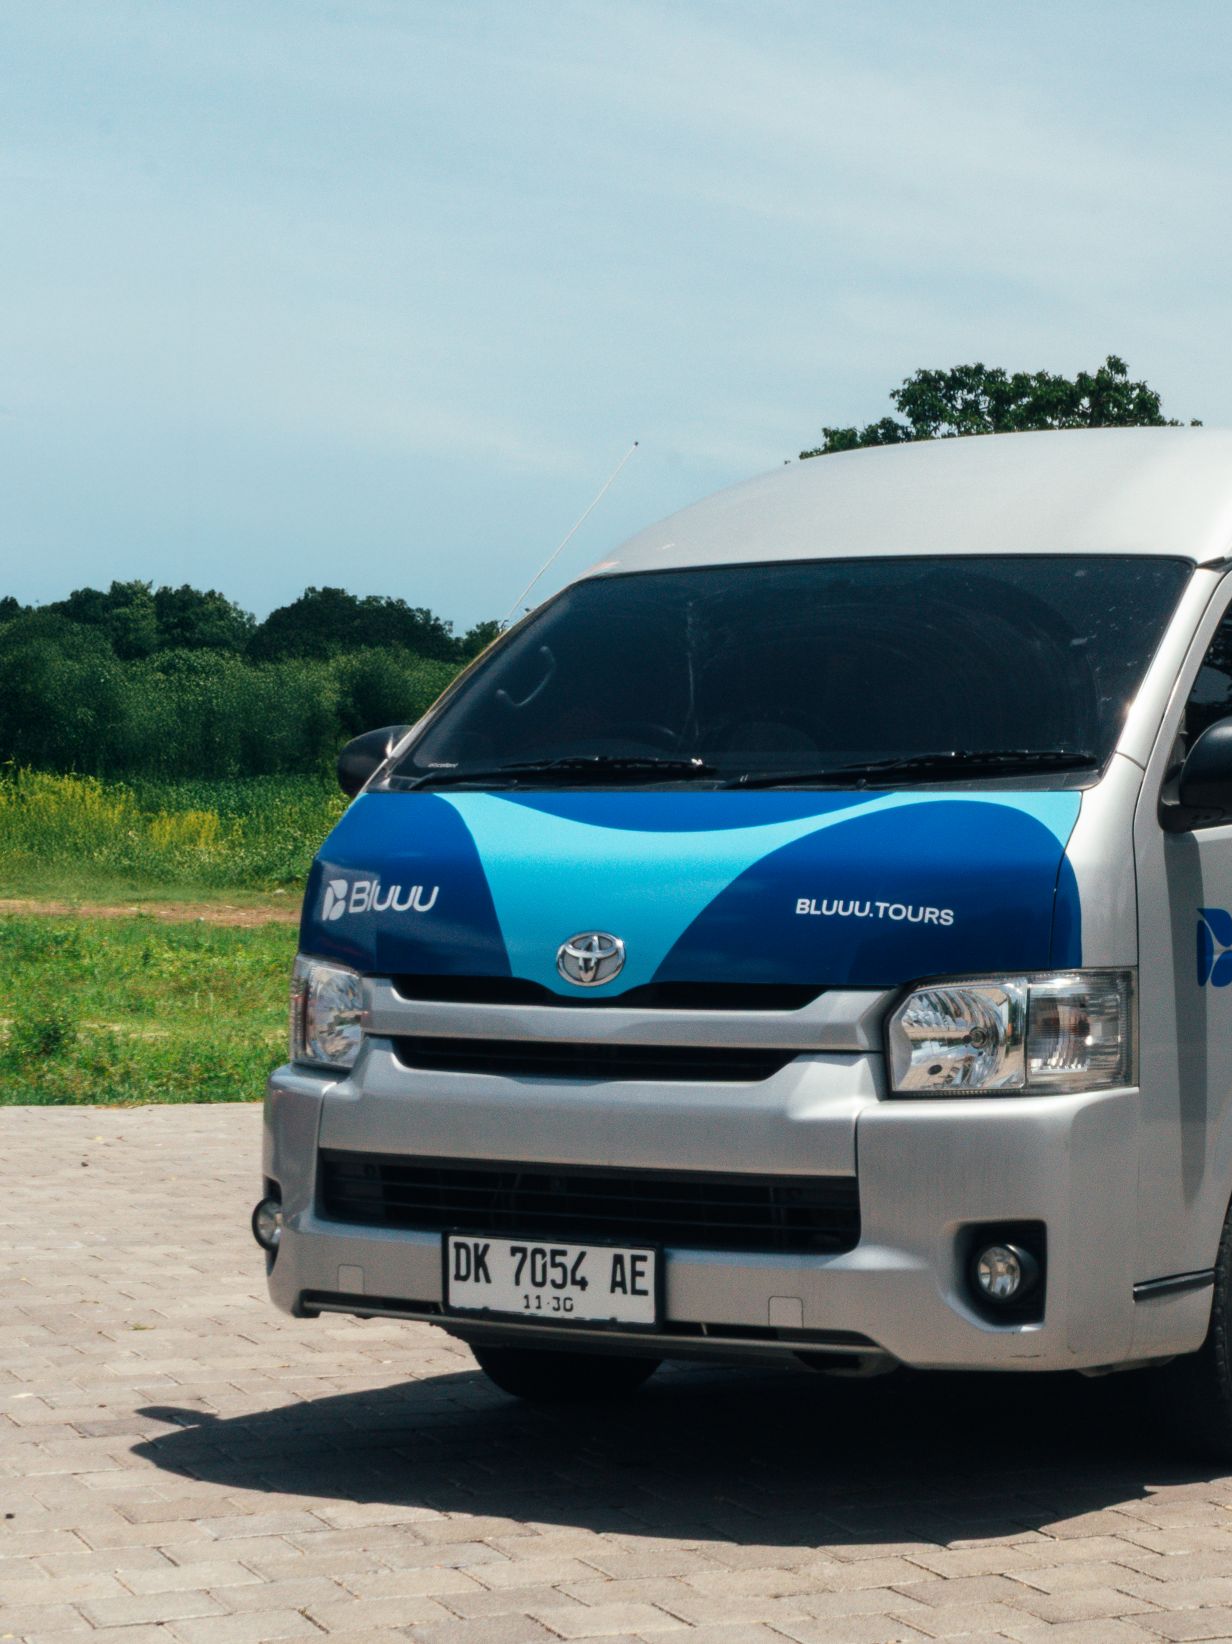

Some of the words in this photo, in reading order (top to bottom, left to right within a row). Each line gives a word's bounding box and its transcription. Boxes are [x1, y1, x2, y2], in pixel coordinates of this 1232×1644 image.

[348, 879, 440, 913] Bluuu
[795, 898, 954, 926] BLUUU.TOURS
[453, 1241, 492, 1284] DK
[510, 1245, 589, 1291] 7054
[610, 1253, 649, 1296] AE
